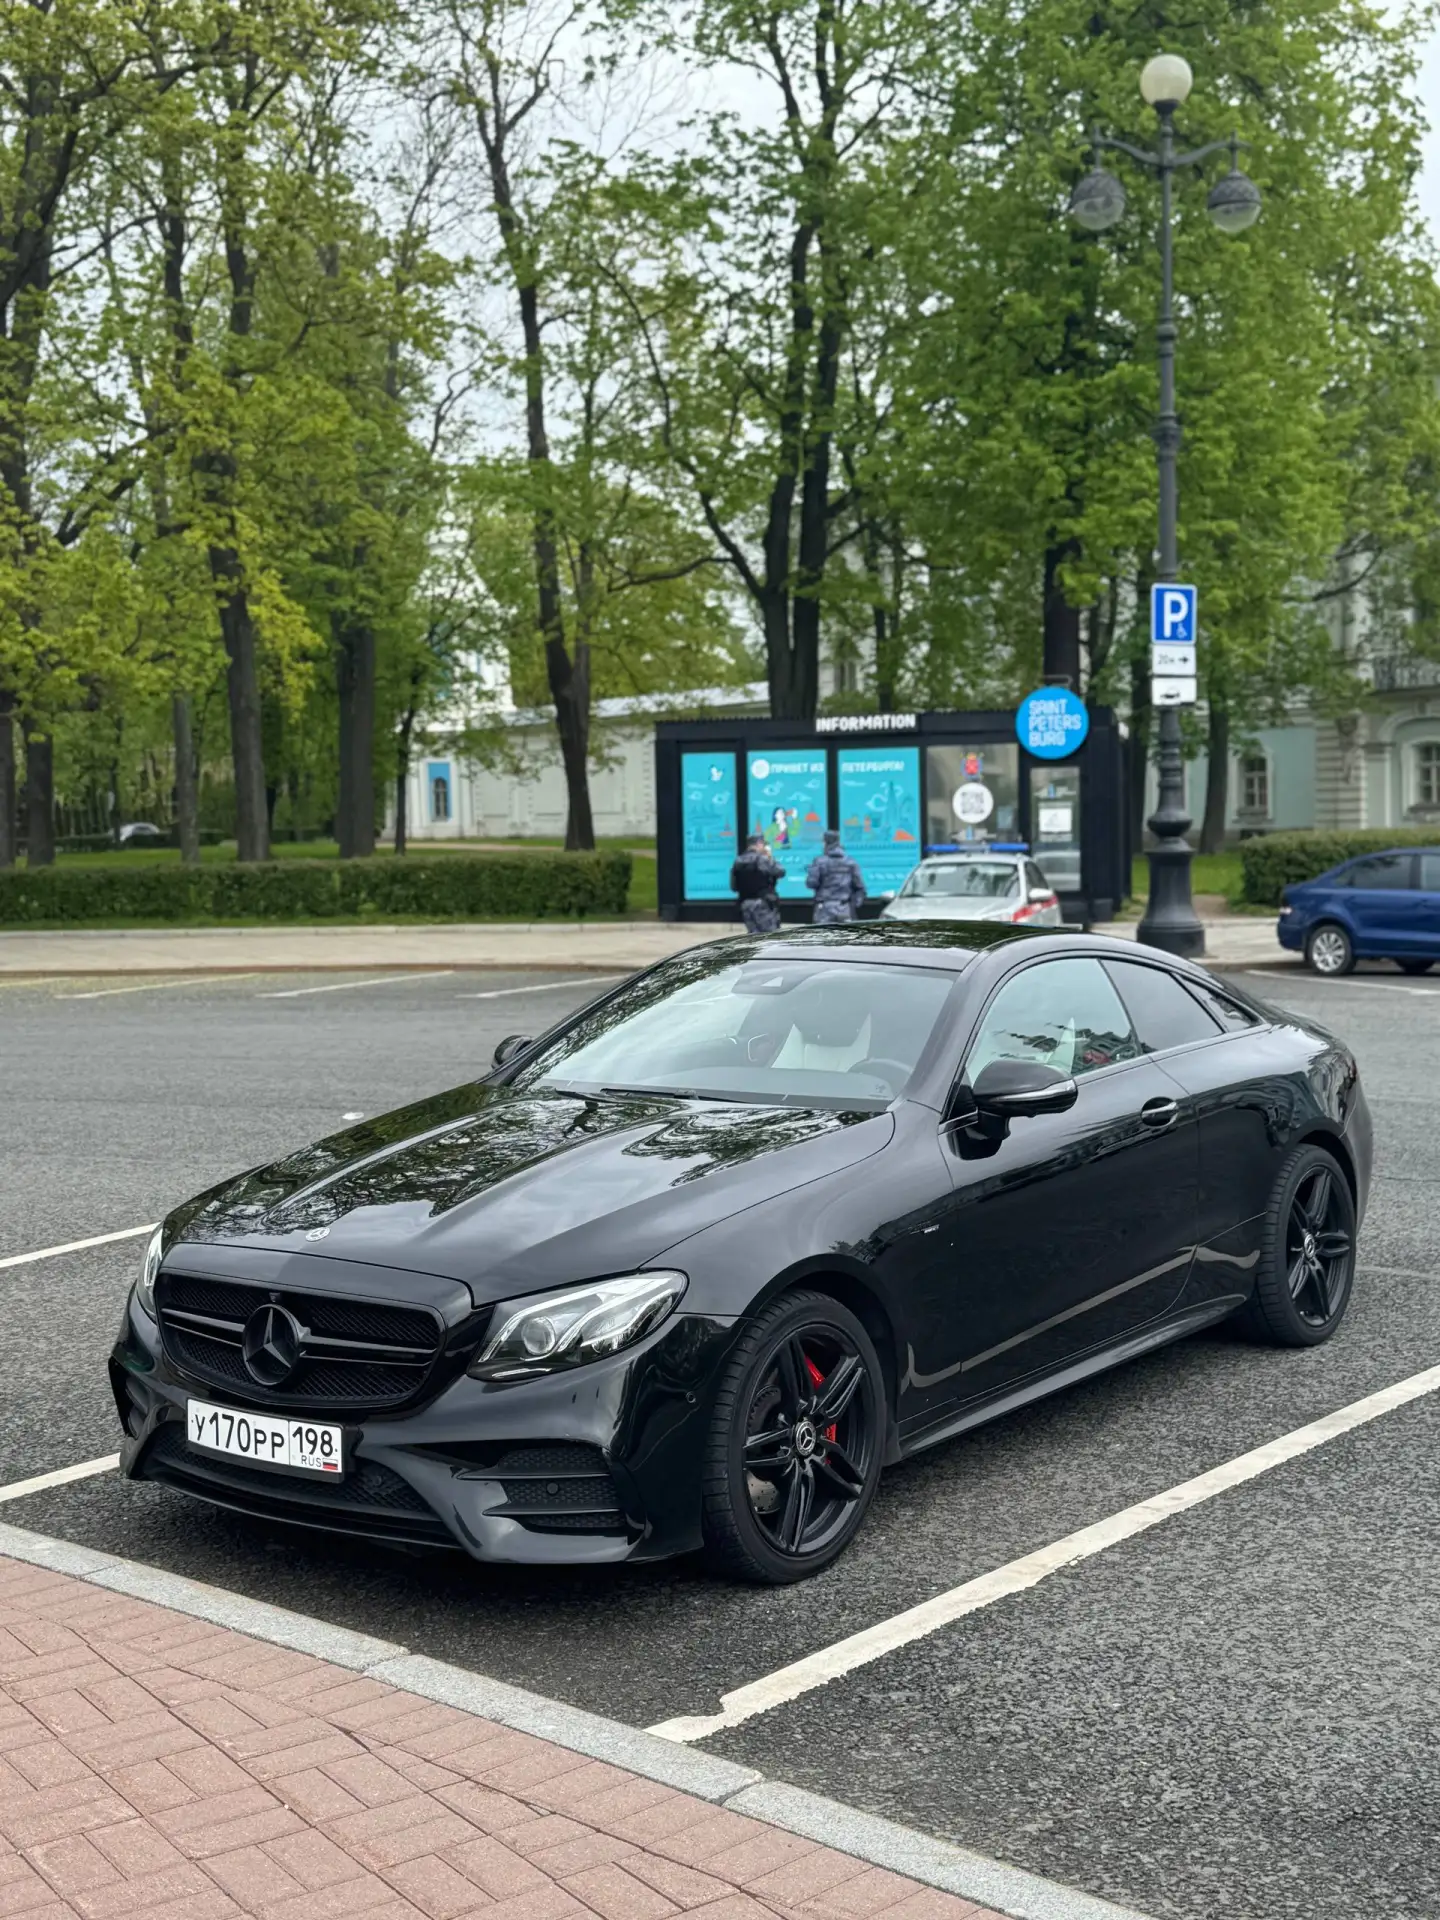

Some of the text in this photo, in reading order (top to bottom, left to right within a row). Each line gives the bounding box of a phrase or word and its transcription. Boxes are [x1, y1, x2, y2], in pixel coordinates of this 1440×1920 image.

[1163, 591, 1188, 638] P
[1029, 699, 1067, 716] SAINT
[816, 714, 916, 732] INFORMATION
[1029, 714, 1081, 731] PETERS
[1029, 731, 1066, 747] BURG
[292, 1426, 333, 1457] 198
[301, 1454, 322, 1468] RUS
